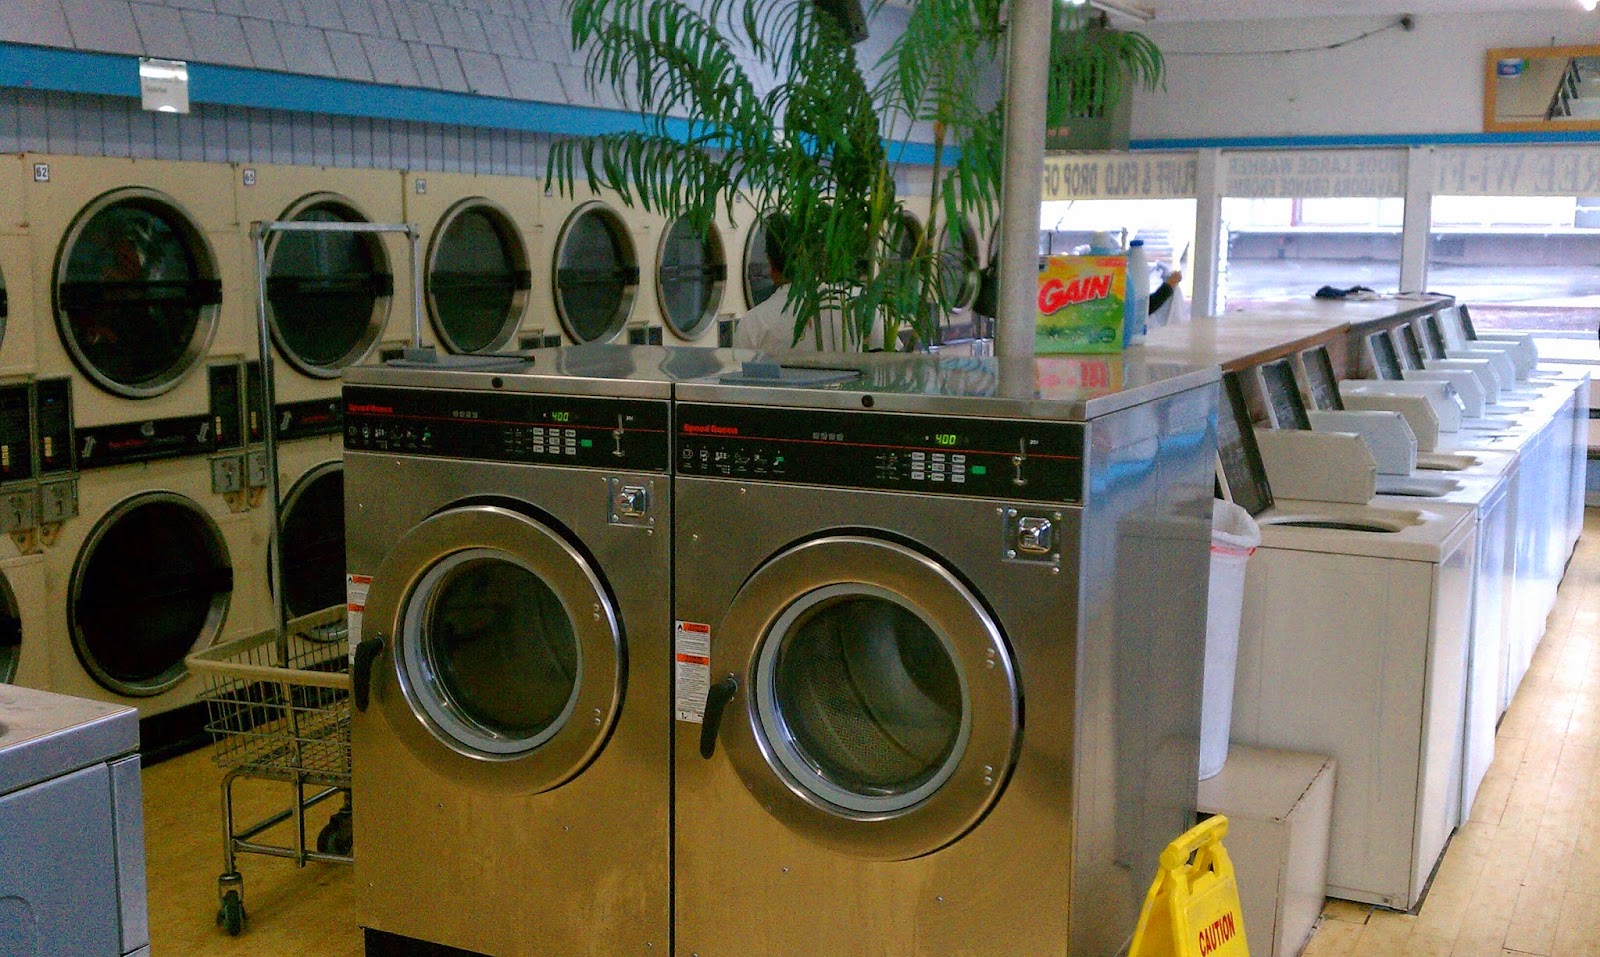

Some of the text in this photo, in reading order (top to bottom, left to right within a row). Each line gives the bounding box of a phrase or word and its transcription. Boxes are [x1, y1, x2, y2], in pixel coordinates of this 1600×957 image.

[1038, 274, 1111, 315] GAIN
[683, 423, 710, 433] Speed
[935, 434, 957, 446] 400
[1198, 911, 1236, 957] CAUTION
